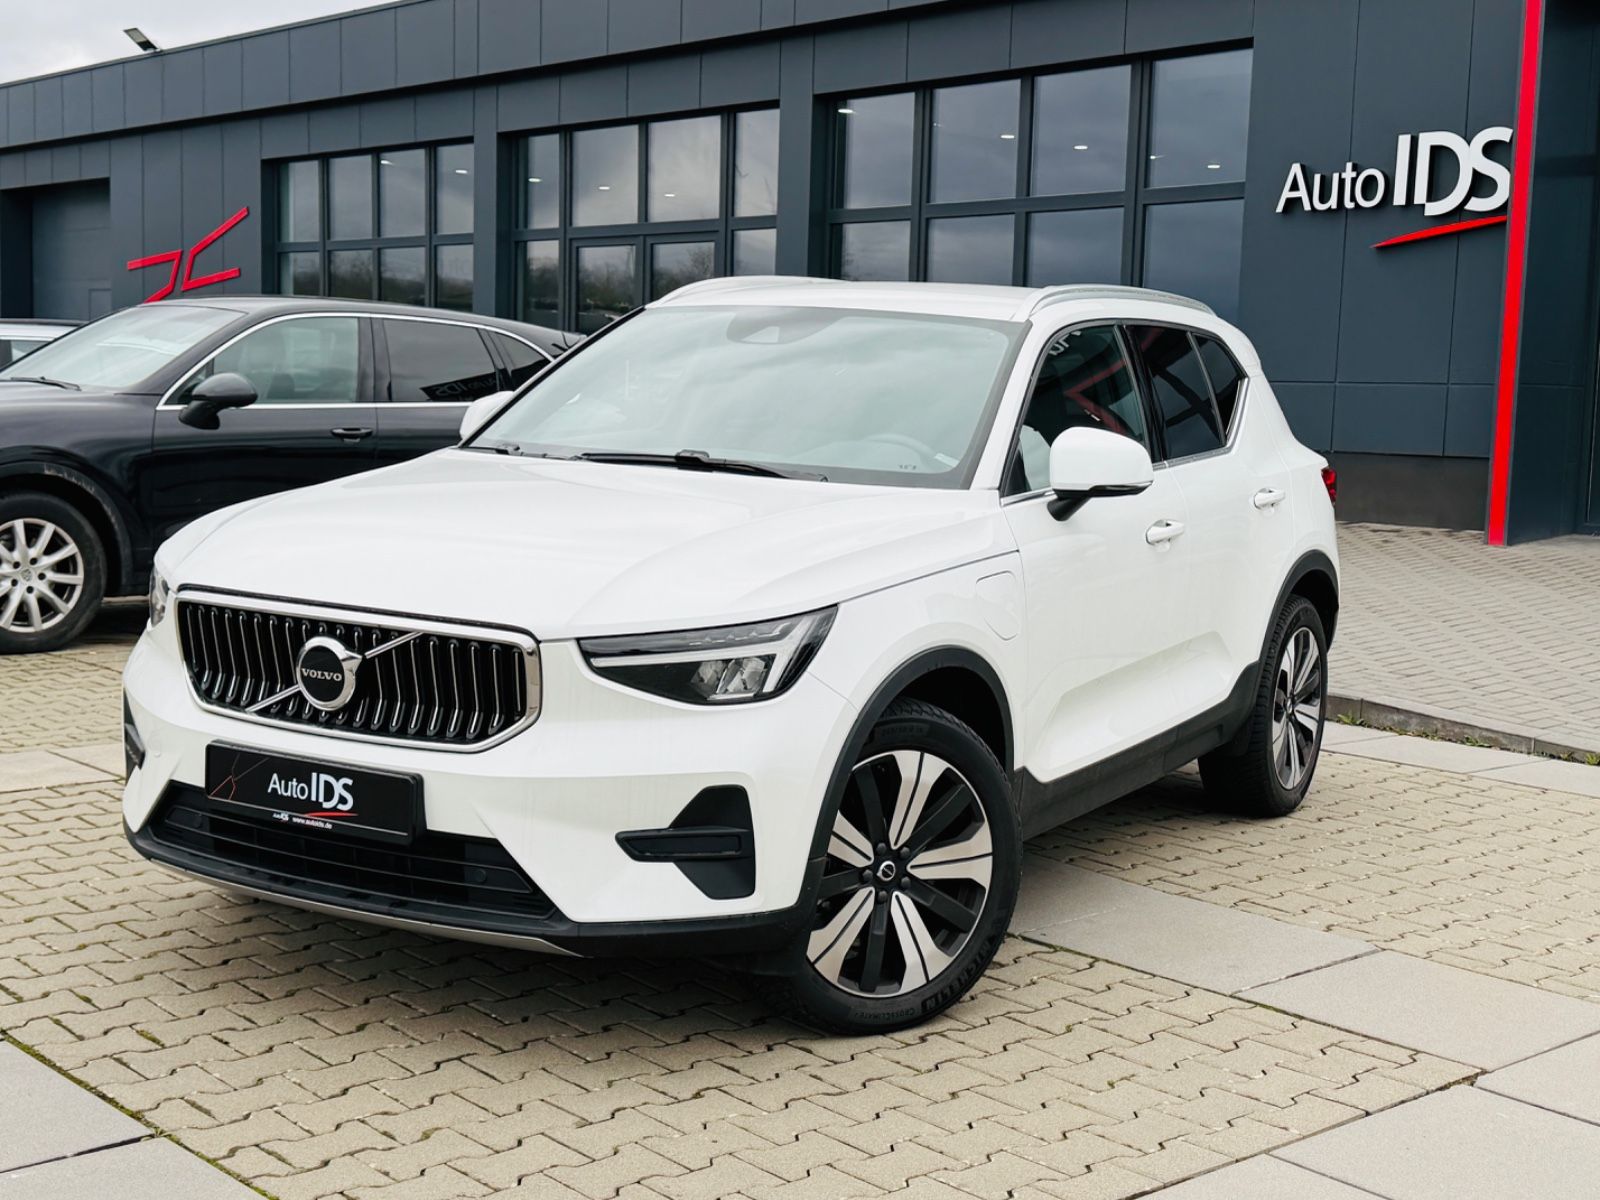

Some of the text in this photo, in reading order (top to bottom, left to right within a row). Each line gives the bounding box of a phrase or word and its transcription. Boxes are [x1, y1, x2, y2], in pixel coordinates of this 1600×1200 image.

[1276, 126, 1513, 216] Auto IDS
[301, 668, 342, 681] VOLVO
[267, 772, 354, 811] Auto IDS
